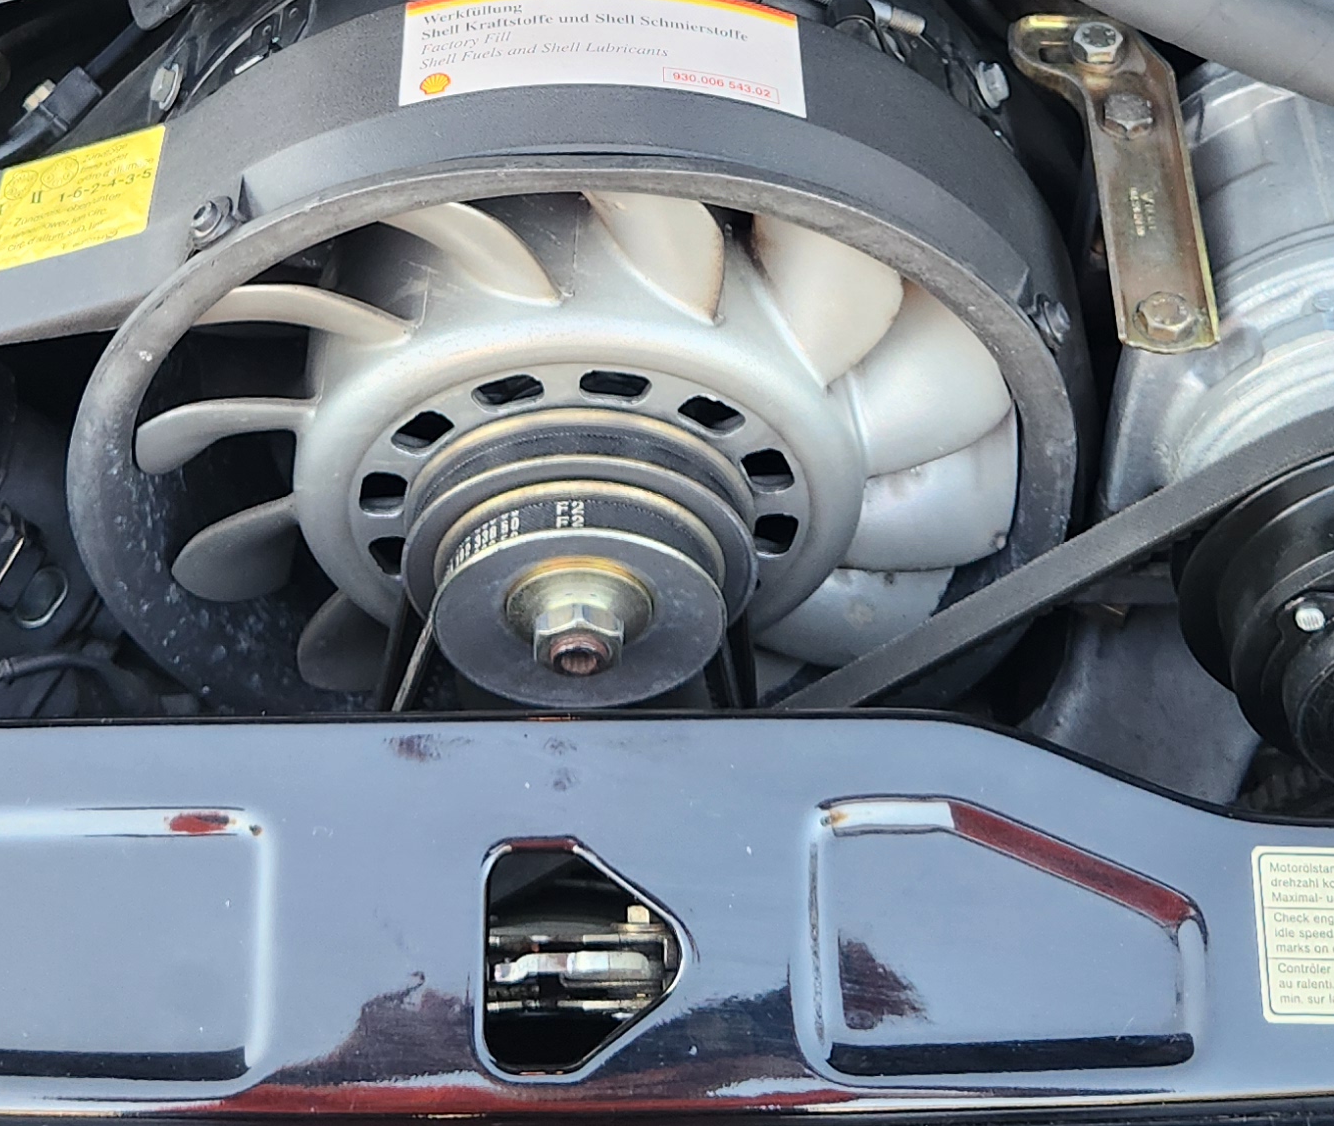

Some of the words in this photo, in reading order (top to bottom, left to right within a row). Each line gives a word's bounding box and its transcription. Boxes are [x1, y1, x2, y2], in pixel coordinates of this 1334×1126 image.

[423, 3, 523, 25] Werkfüllung
[421, 24, 459, 41] Shell
[466, 13, 554, 32] Kraftstoffe
[559, 13, 589, 24] und
[595, 13, 635, 24] Shell
[640, 16, 749, 42] Schmierstoffe
[421, 37, 479, 56] Factory
[484, 31, 512, 44] Fill
[419, 53, 457, 70] Shell
[461, 47, 503, 62] Fuels
[507, 43, 538, 56] and
[541, 42, 581, 54] Shell
[586, 42, 669, 58] Lubricants
[59, 168, 152, 202] 1-6-2-4-3-5
[1270, 878, 1319, 888] drehzahl
[1271, 892, 1323, 903] Maximal-
[1273, 912, 1309, 923] Check
[1275, 928, 1295, 939] idle
[1276, 943, 1311, 954] marks
[1314, 945, 1329, 954] on
[1277, 962, 1332, 974] Contrôler
[1278, 980, 1293, 989] au
[1296, 979, 1334, 990] ralenti.
[1280, 994, 1303, 1004] min.
[1307, 995, 1325, 1005] sur
